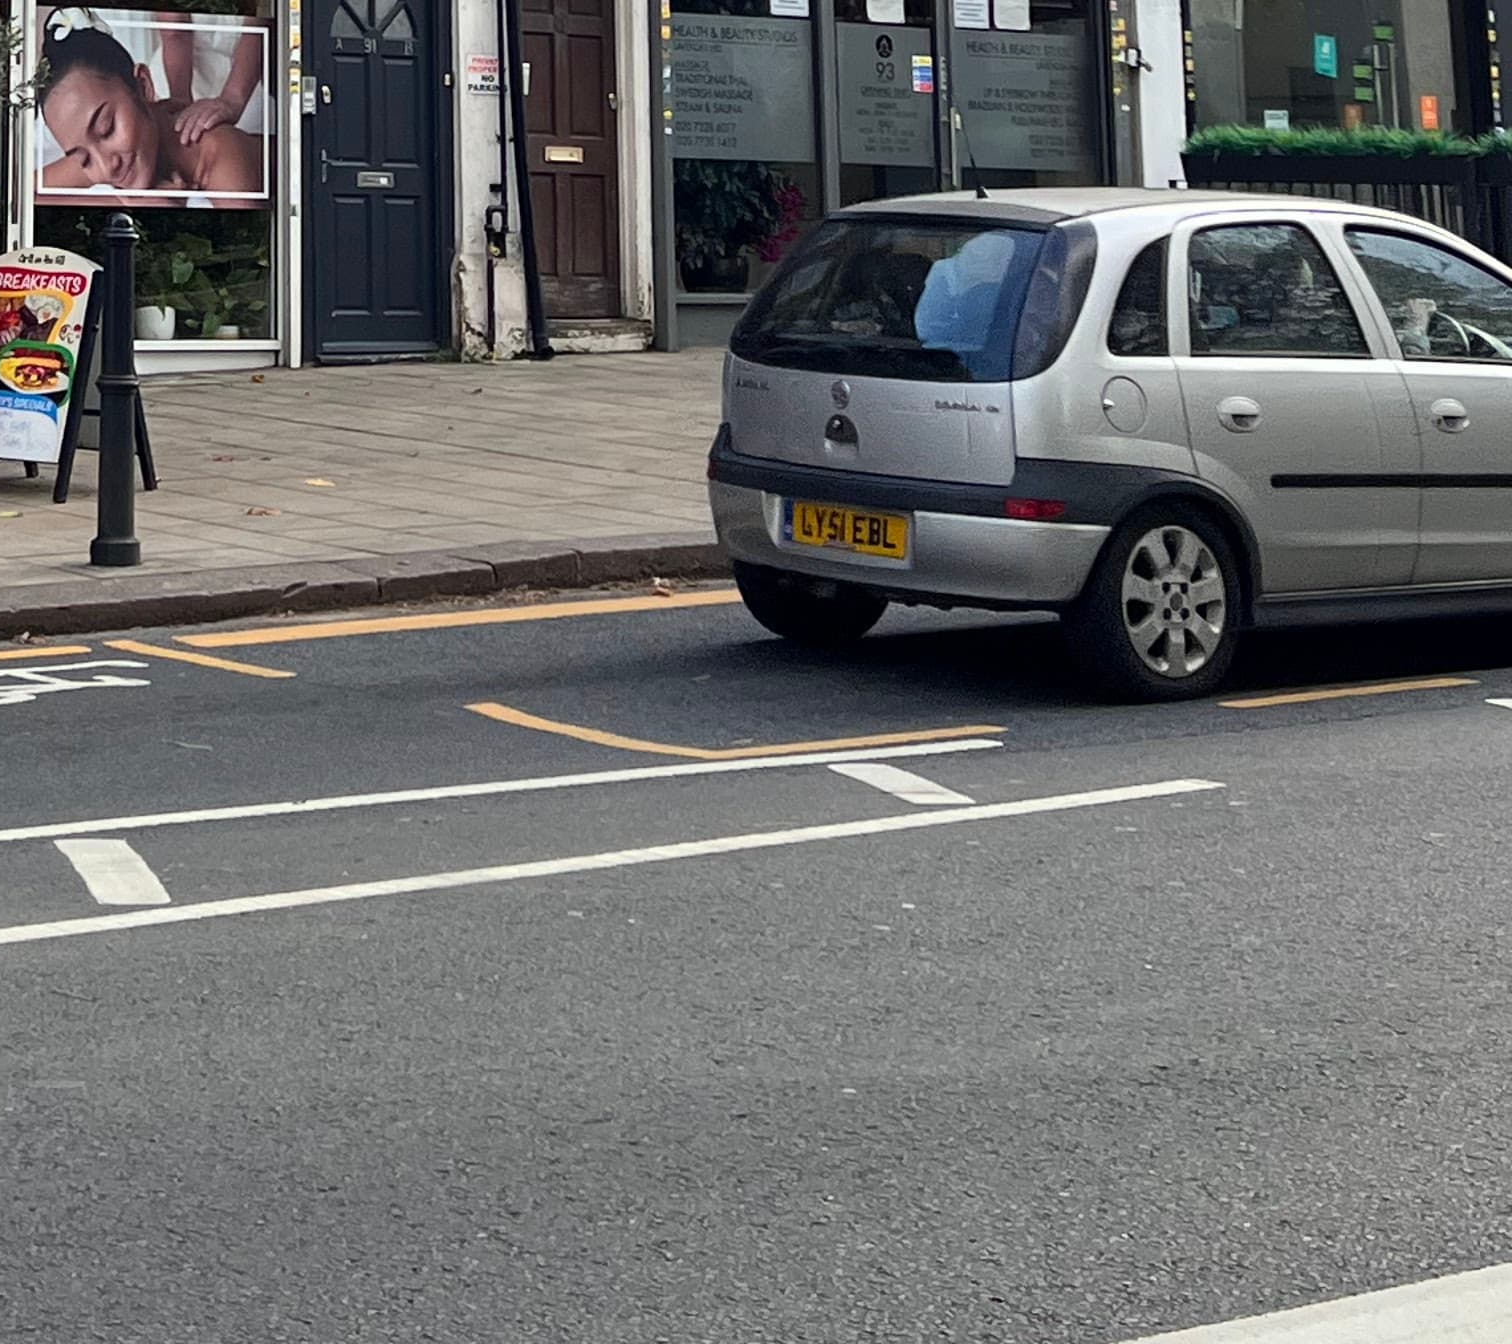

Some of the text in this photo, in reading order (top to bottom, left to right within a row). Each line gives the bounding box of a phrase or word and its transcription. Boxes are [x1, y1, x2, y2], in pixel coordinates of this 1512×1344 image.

[364, 38, 377, 54] 91
[481, 74, 495, 83] NO
[875, 61, 895, 81] 93
[801, 504, 897, 549] LY51 EBL
